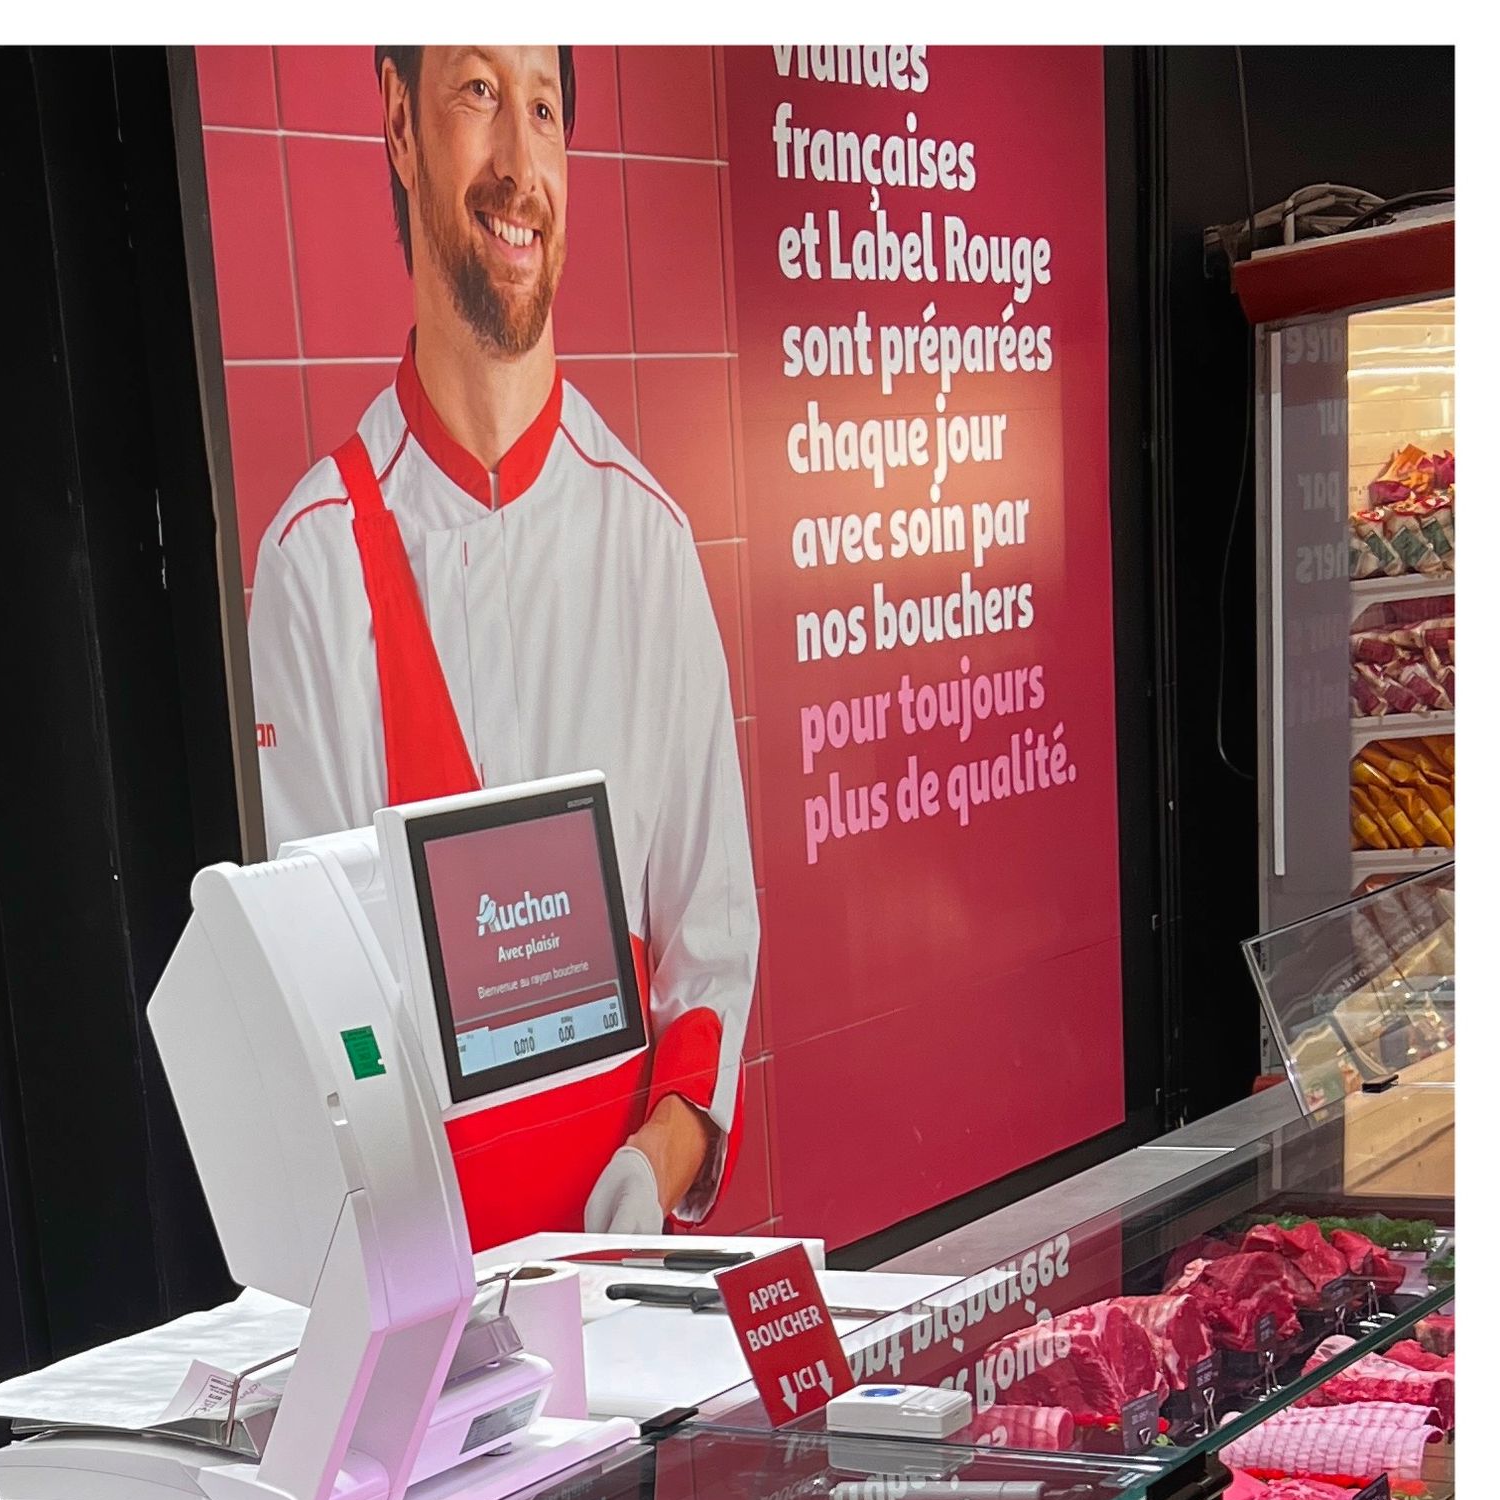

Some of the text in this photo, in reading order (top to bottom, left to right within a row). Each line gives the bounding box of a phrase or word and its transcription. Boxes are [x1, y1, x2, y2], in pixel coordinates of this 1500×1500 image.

[772, 102, 977, 211] françaises
[778, 209, 1051, 304] et Label Rouge
[782, 302, 1053, 395] sont préparées
[787, 392, 1006, 488] chaque jour
[791, 483, 1030, 568] avec soin par
[795, 572, 1034, 662] nos bouchers
[800, 655, 1045, 774] pour toujours
[804, 722, 1076, 865] plus de qualité.
[476, 890, 570, 937] Auchan
[498, 932, 560, 963] Avec plaisir
[477, 979, 518, 1000] Bienvenue
[531, 970, 553, 987] rayon
[553, 960, 589, 979] boucherie
[745, 1304, 824, 1352] BOUCHER
[748, 1278, 799, 1314] APPEL
[793, 1367, 816, 1393] ICI
